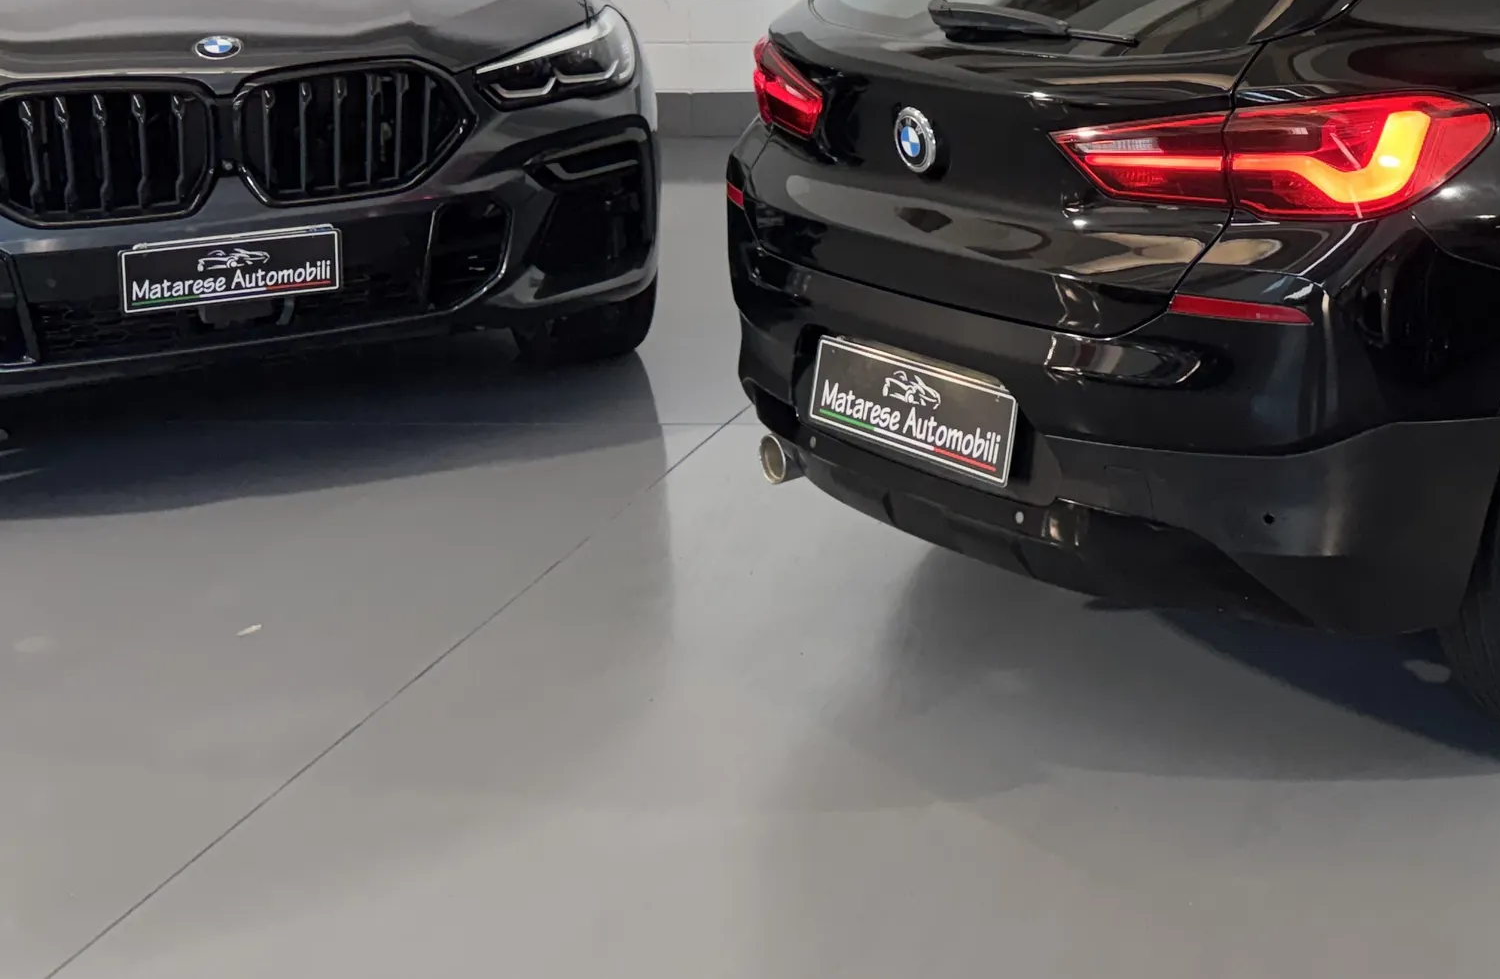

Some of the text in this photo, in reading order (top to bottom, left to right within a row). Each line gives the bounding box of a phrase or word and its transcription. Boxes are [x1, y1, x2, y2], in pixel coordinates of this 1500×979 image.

[131, 259, 331, 301] Matarese Automobili
[820, 378, 1002, 465] Matarese Automobili
